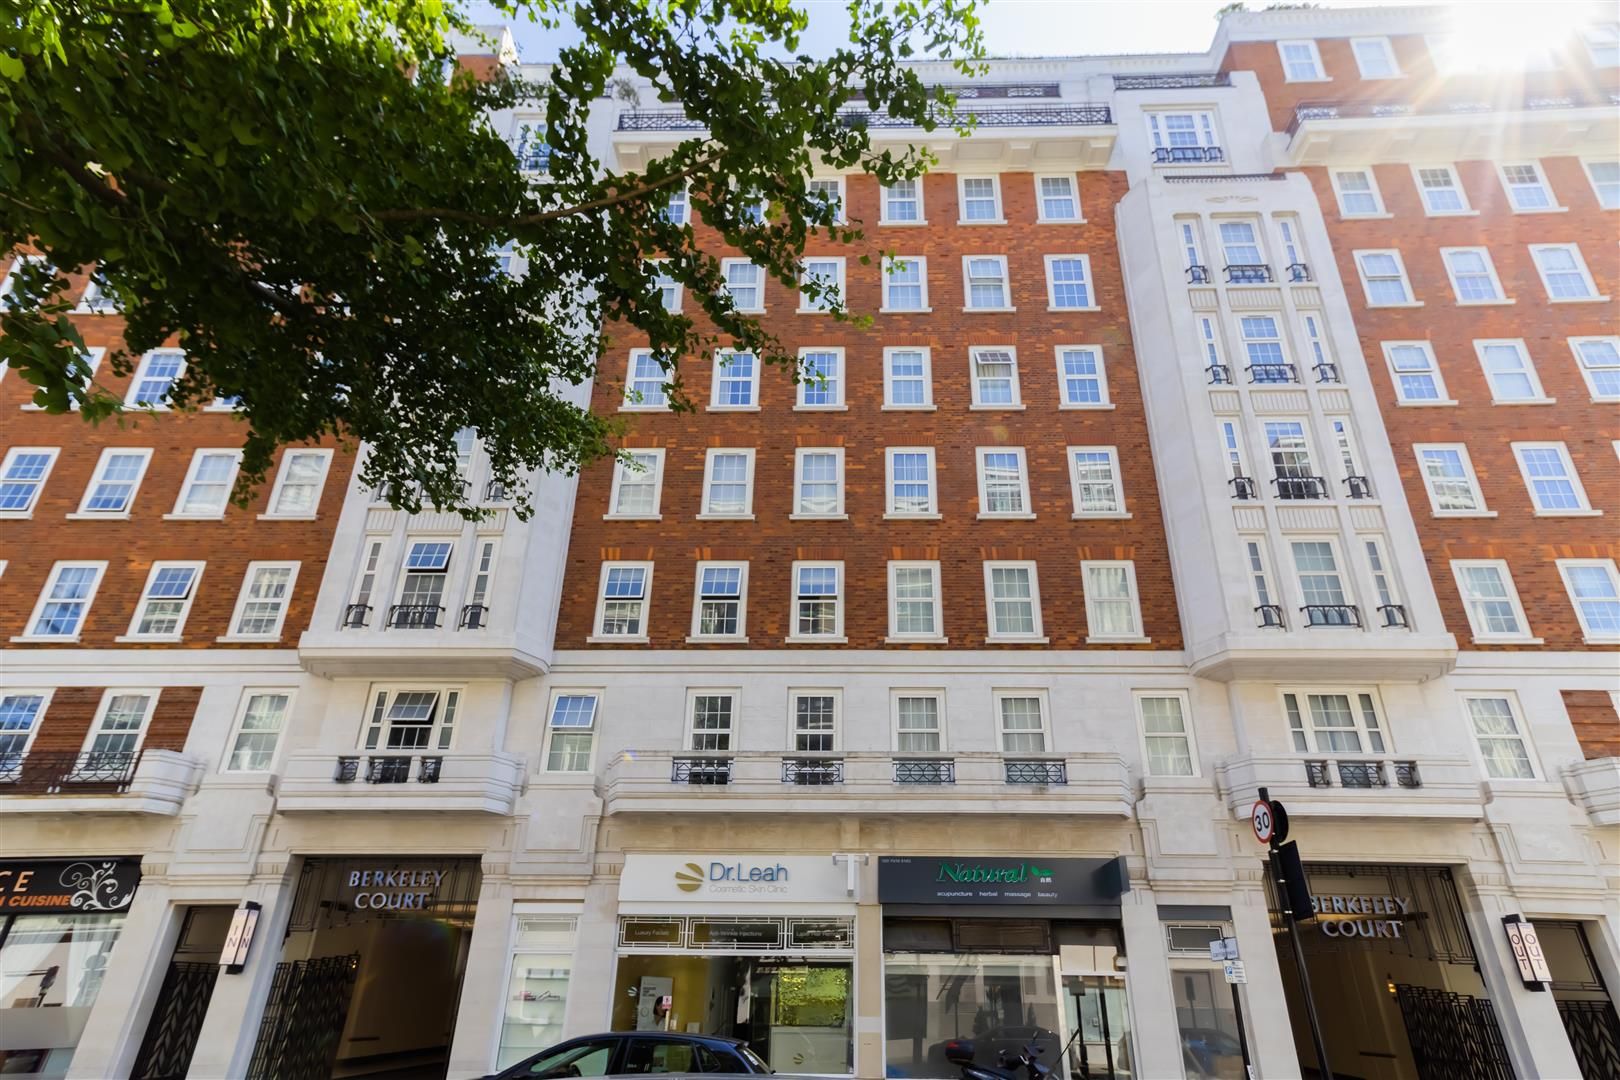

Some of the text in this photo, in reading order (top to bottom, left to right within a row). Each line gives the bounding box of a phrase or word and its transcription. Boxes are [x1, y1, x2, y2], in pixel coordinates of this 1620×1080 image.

[1255, 811, 1270, 832] 30
[348, 870, 448, 887] BERKELEY
[936, 864, 1028, 882] Natural
[709, 885, 788, 893] Cosmetic Skin Clinic
[8, 895, 71, 908] CUISINE
[354, 892, 430, 909] COURT
[1310, 895, 1410, 914] BERKELEY
[240, 925, 251, 948] IN
[1322, 919, 1402, 938] COURT
